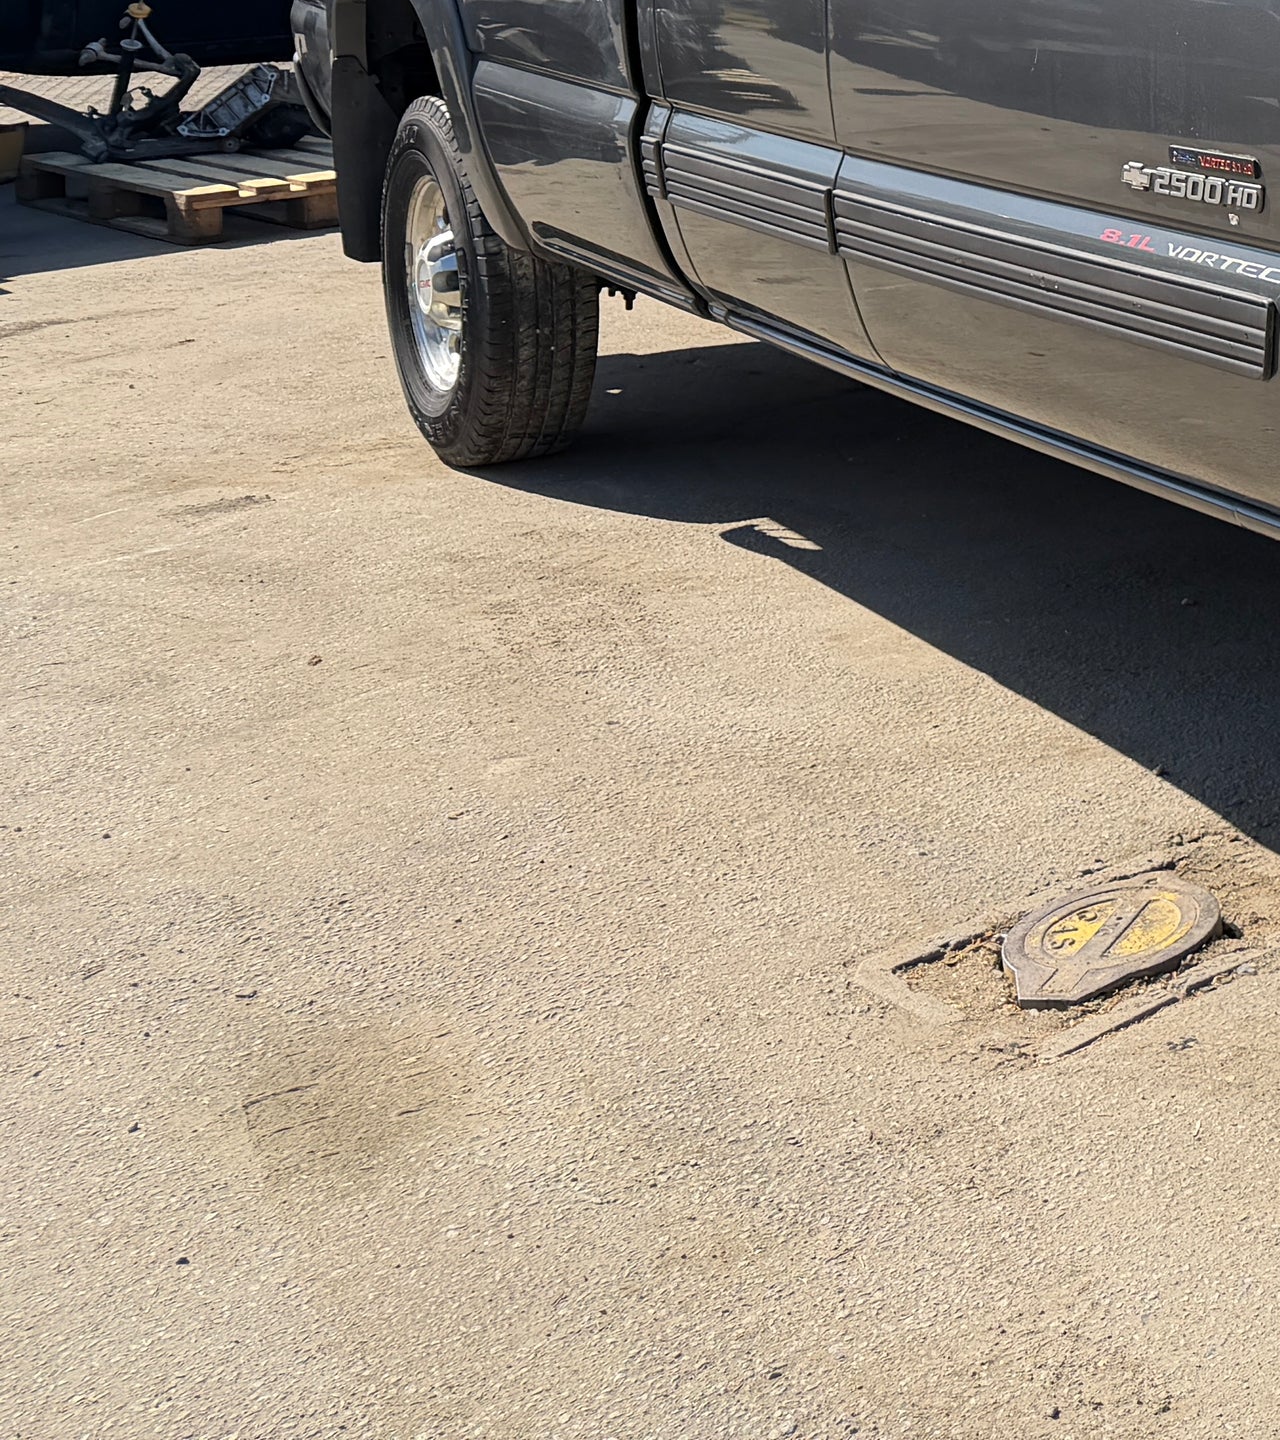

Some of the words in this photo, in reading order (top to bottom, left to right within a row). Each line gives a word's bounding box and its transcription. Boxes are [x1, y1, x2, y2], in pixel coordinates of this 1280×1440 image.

[1153, 171, 1222, 205] 2500
[1226, 184, 1258, 210] HD
[1099, 227, 1156, 254] 8.1L
[1050, 909, 1099, 951] GAS
